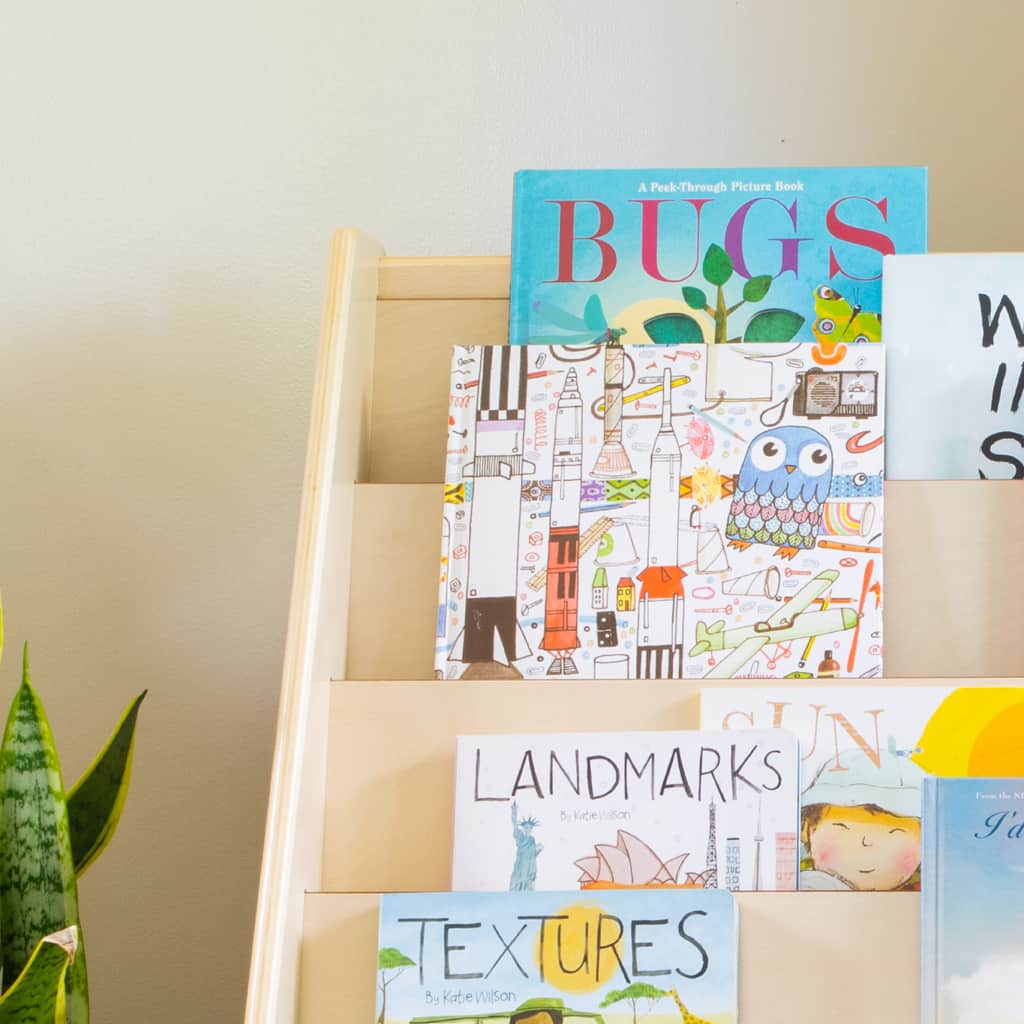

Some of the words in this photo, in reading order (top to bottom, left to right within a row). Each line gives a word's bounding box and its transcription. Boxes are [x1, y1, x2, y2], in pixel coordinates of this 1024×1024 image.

[638, 182, 647, 193] A
[651, 181, 727, 194] Peek-Through
[731, 181, 771, 192] Picture
[775, 180, 804, 192] Book
[542, 196, 896, 284] BUGS
[473, 743, 784, 803] LANDMARKS
[397, 909, 709, 985] TEXTURES
[425, 990, 440, 1006] By
[442, 988, 473, 1006] Katie
[475, 988, 517, 1004] Wilson
